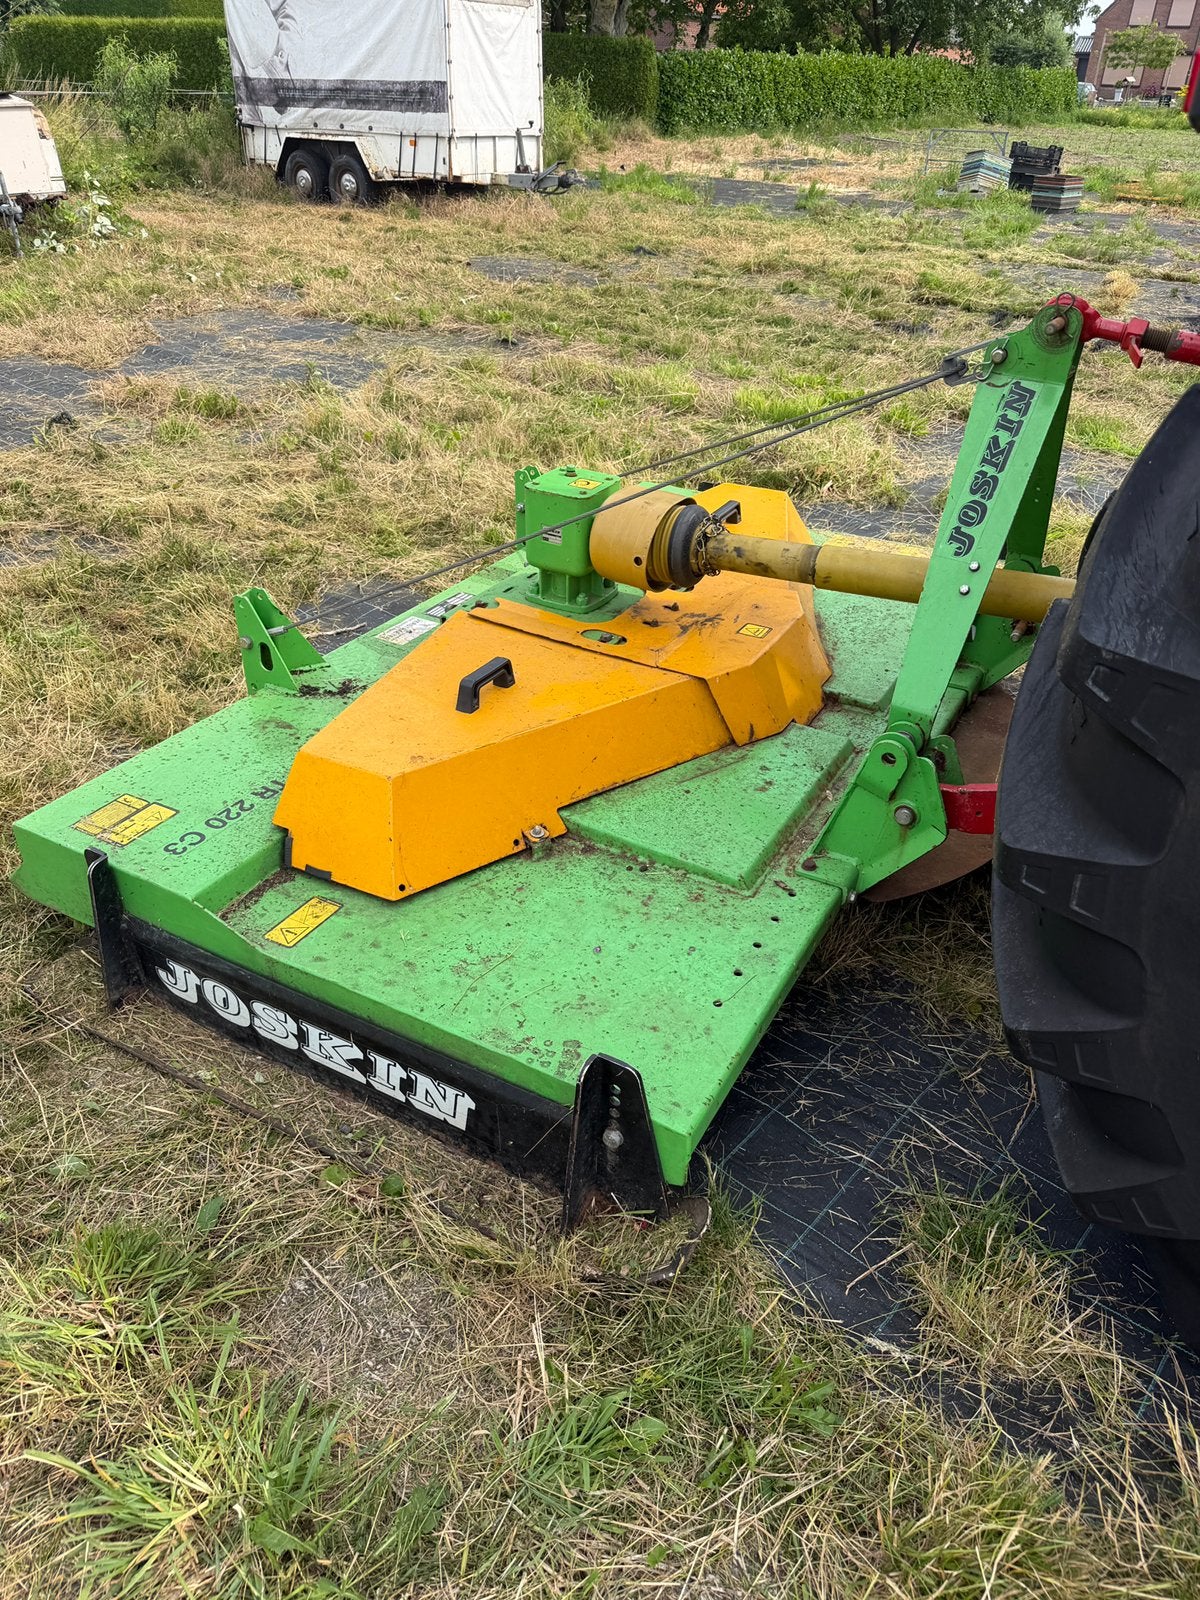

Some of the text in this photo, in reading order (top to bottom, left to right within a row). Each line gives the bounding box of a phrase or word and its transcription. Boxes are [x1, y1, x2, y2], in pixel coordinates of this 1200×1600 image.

[947, 380, 1037, 557] JOSKIN
[163, 831, 206, 855] C3
[204, 799, 255, 829] 220
[154, 958, 476, 1132] JOSKIN
